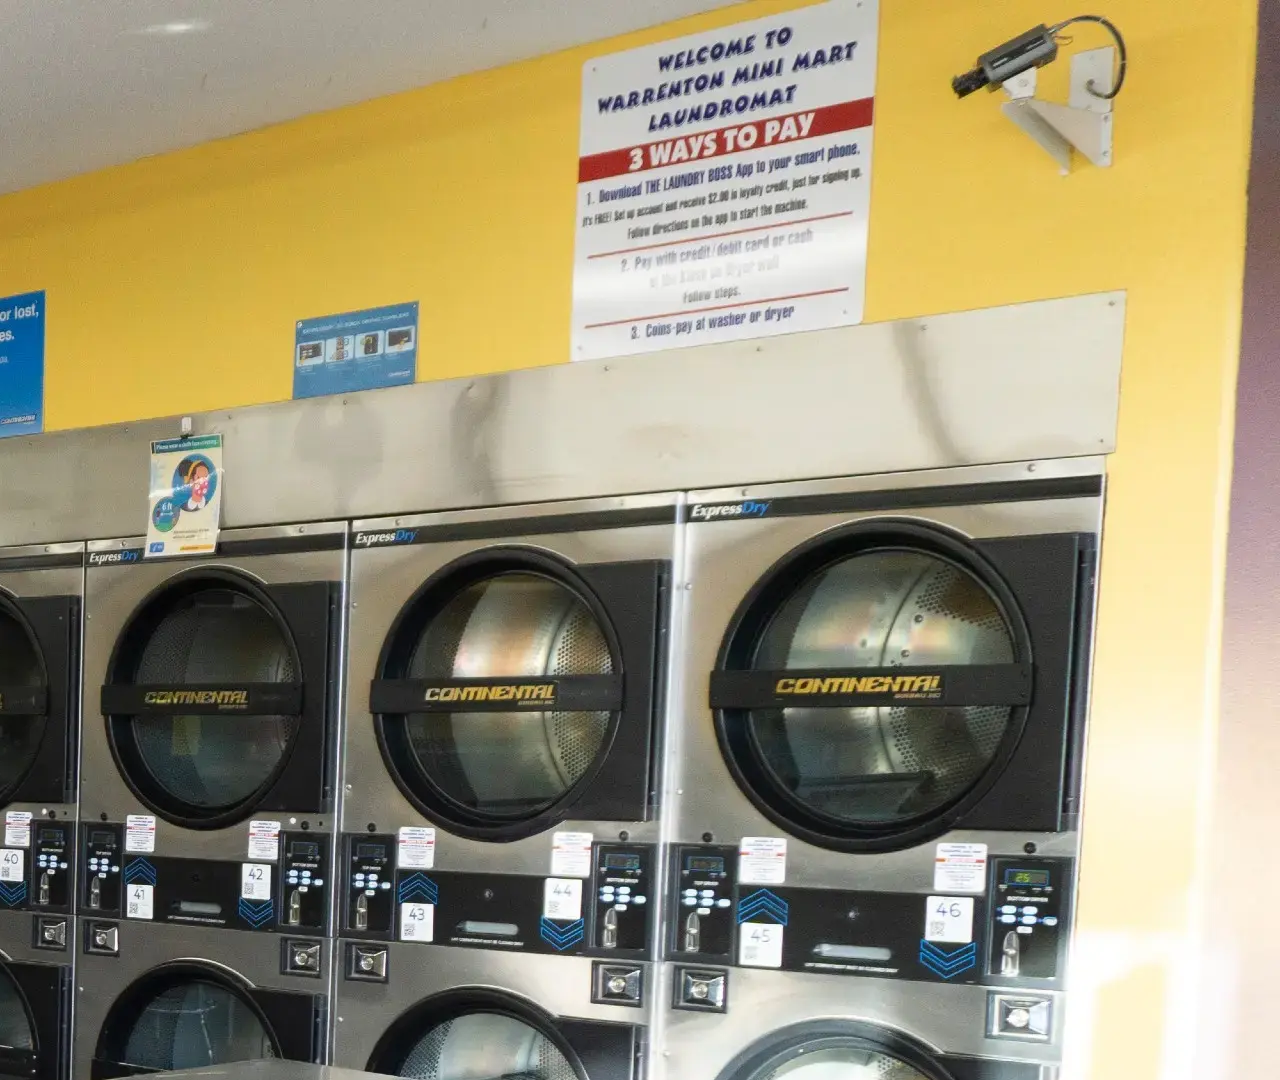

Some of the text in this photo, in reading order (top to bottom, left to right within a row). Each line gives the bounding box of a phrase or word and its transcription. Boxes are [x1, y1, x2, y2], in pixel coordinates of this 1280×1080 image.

[658, 27, 793, 72] WELCOME TO
[598, 42, 858, 114] WARRENTON MINI MART
[648, 85, 798, 132] LAUNDROMAT
[628, 113, 815, 171] 3 WAYS TO PAY
[599, 180, 643, 203] Download
[645, 178, 661, 193] THE
[663, 170, 705, 191] LAUNDRY
[708, 164, 733, 183] BOSS
[736, 161, 754, 179] App
[756, 158, 766, 172] to
[768, 156, 792, 174] your
[795, 149, 825, 166] smart
[827, 142, 861, 163] phone.
[636, 203, 664, 218] account
[679, 195, 707, 210] receive
[627, 224, 651, 240] Follow
[634, 255, 652, 271] Pay
[656, 251, 677, 268] with
[745, 234, 770, 252] card
[14, 304, 40, 319] lost,
[631, 325, 641, 340] 3.
[696, 315, 706, 331] at
[708, 310, 747, 330] washer
[749, 310, 762, 324] or
[764, 304, 795, 323] dryer
[691, 500, 769, 519] ExpressDry
[355, 528, 418, 545] ExpressDry
[89, 550, 139, 564] ExpressDry
[425, 684, 556, 701] CONTINENTAL
[775, 675, 941, 695] CONTINENTAL
[144, 691, 249, 706] CONTINENTAL
[3, 853, 19, 865] 40
[248, 868, 263, 881] 42
[133, 889, 145, 900] 41
[553, 883, 572, 897] 44
[408, 907, 425, 921] 43
[935, 902, 962, 918] 46
[750, 928, 771, 943] 45
